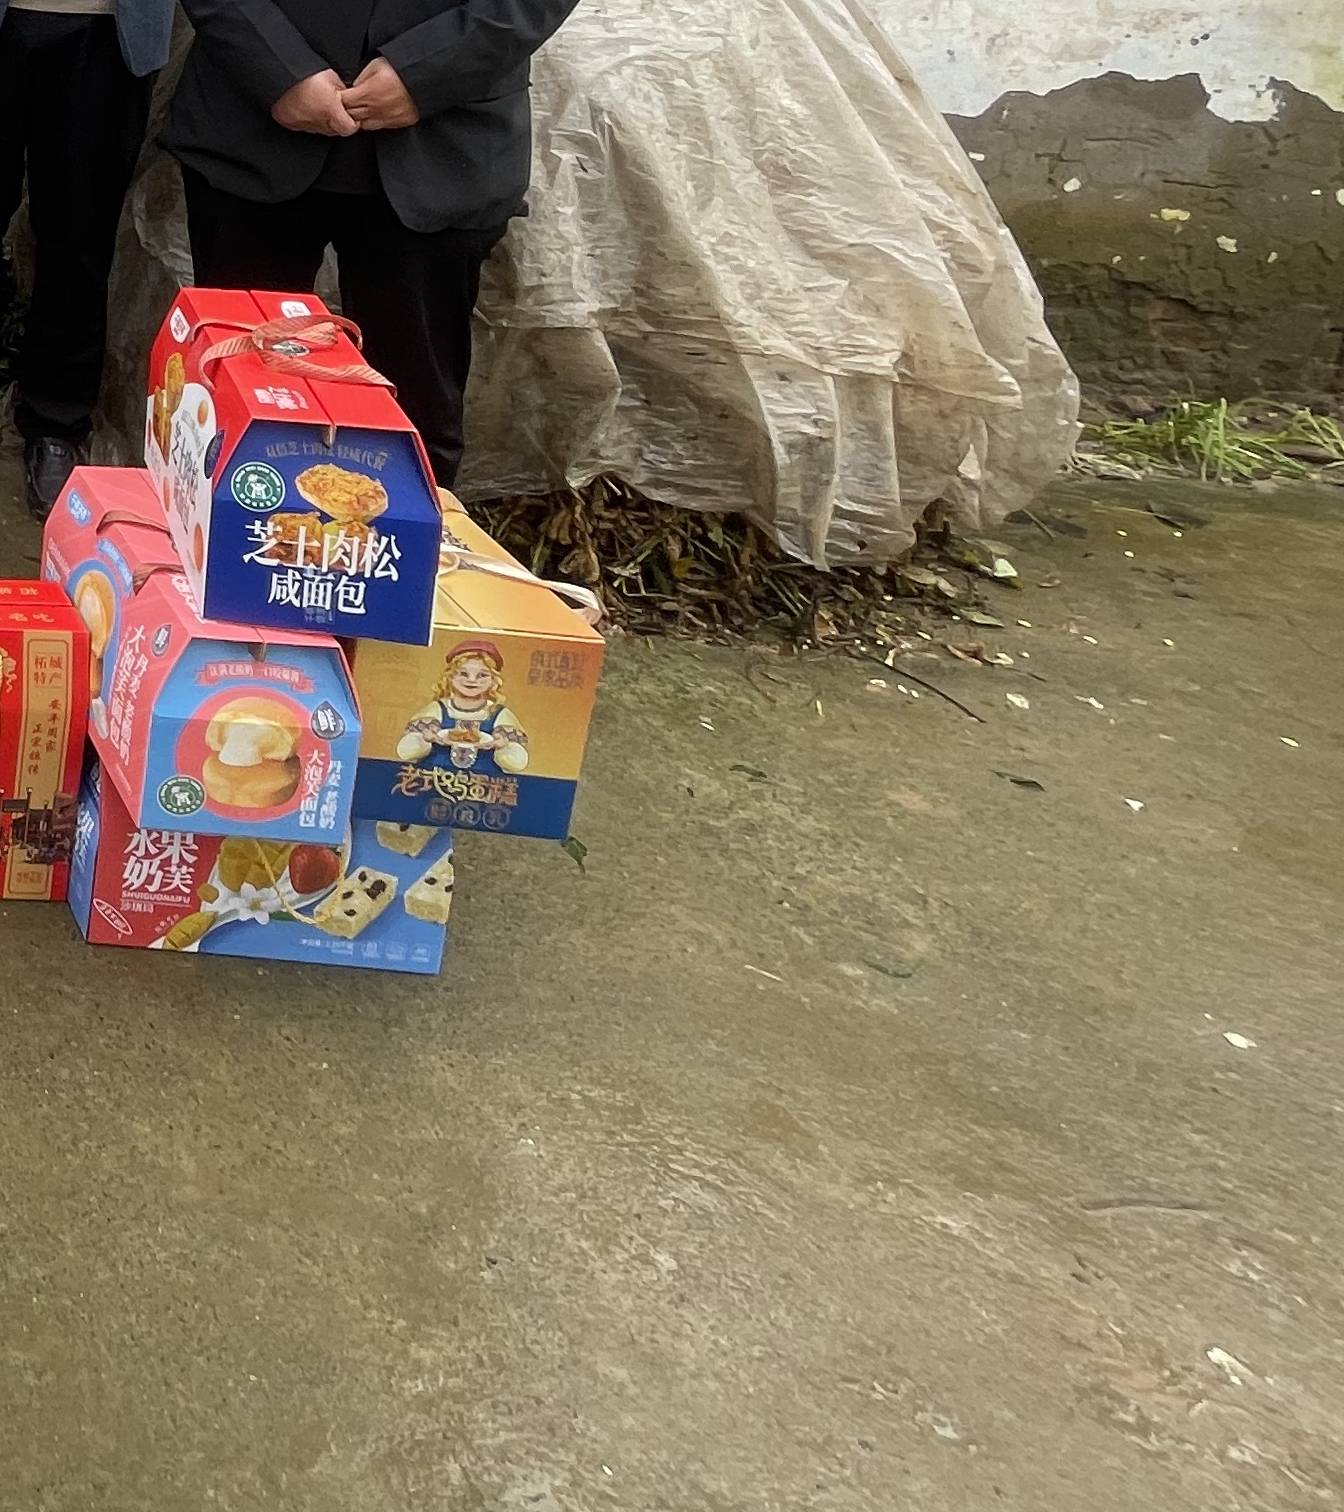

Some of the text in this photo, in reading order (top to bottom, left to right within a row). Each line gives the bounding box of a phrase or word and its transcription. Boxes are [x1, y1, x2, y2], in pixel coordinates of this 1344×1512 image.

[242, 519, 402, 583] 芝士肉松
[267, 568, 367, 615] 咸面包
[123, 830, 199, 865] 水果
[121, 855, 196, 895] 奶芙
